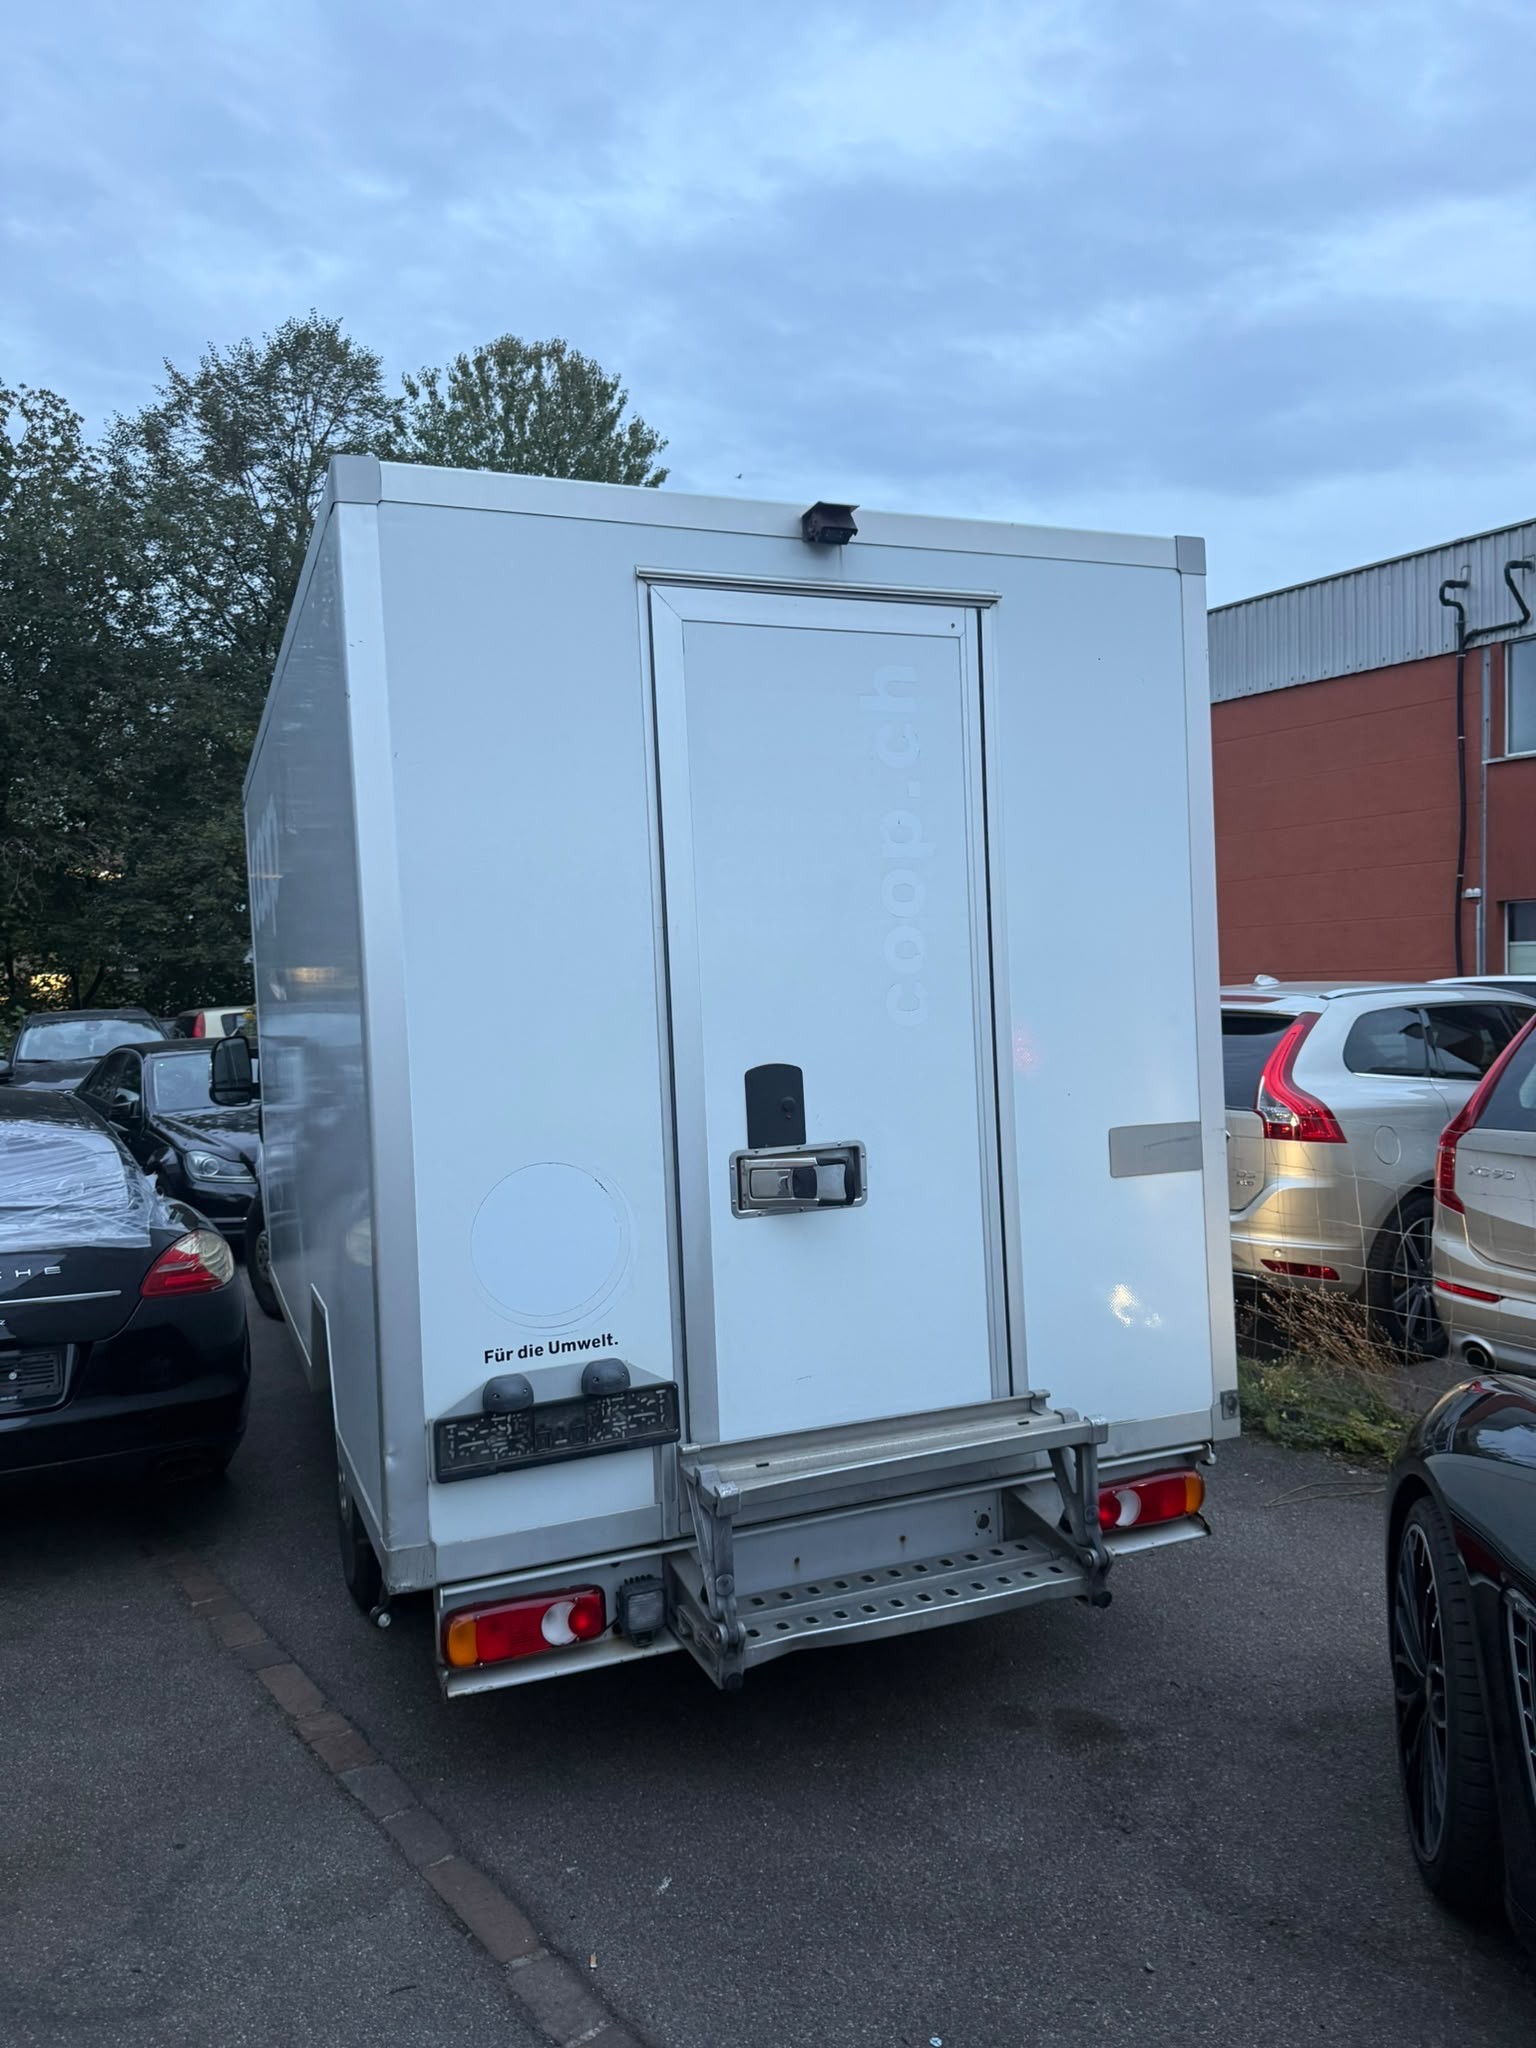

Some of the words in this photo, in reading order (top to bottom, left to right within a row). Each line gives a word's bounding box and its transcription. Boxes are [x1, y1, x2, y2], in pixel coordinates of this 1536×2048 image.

[859, 664, 938, 1029] coop.ch
[0, 1265, 61, 1279] HE
[484, 1347, 514, 1364] Für
[517, 1343, 544, 1359] die
[548, 1332, 619, 1354] Umwelt.
